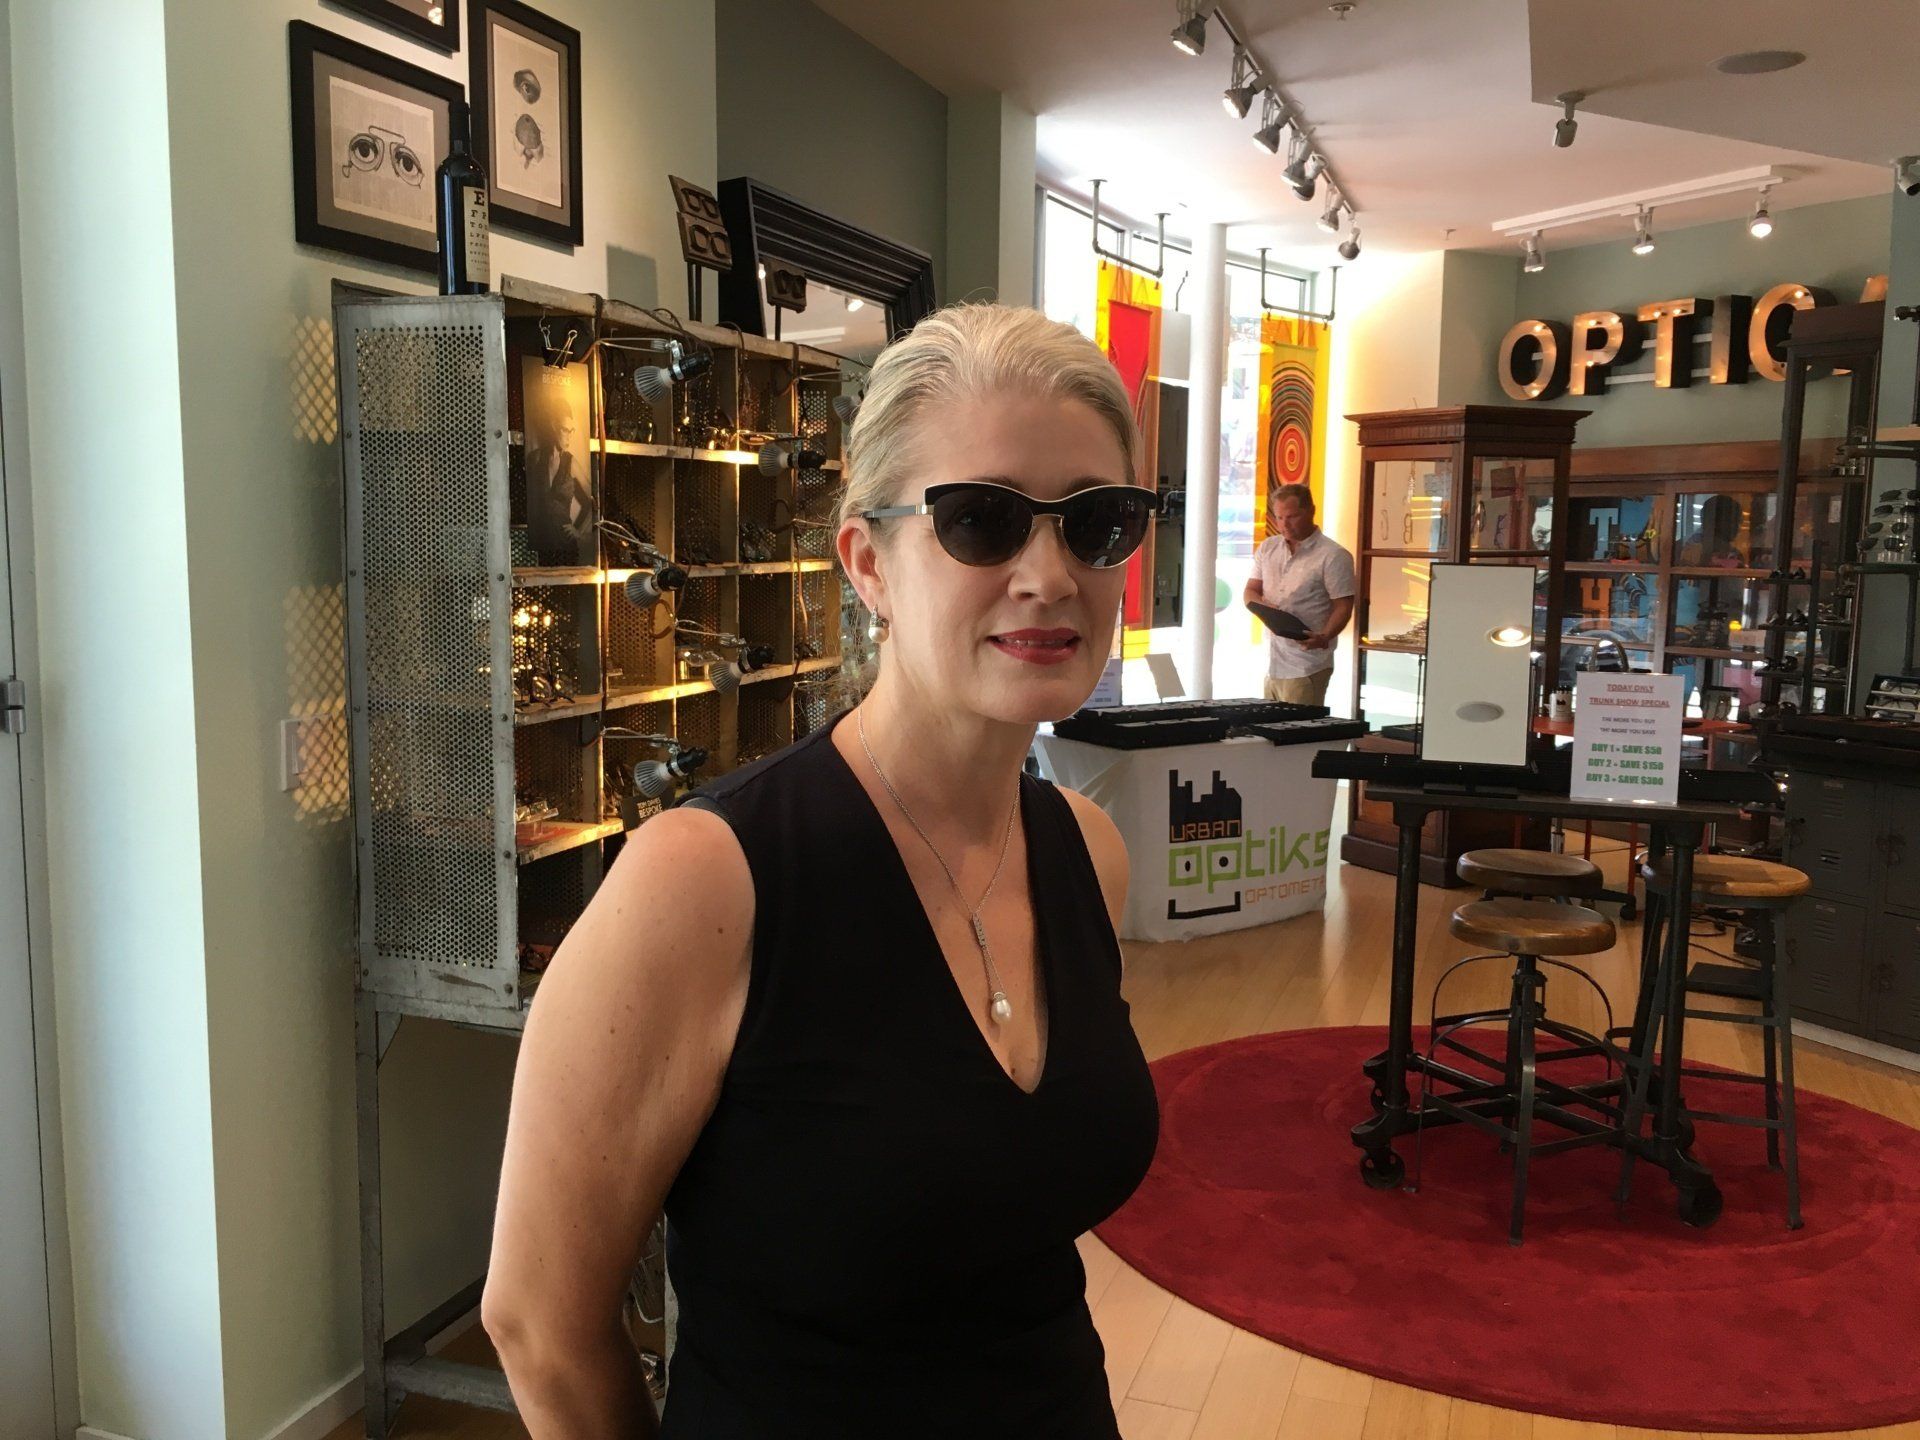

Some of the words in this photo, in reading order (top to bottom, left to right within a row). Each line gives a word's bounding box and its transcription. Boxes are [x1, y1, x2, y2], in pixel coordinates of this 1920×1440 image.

[474, 191, 485, 206] E
[1498, 274, 1889, 401] OPTIC
[1607, 684, 1633, 693] TODAY
[1634, 685, 1655, 694] ONLY
[1589, 697, 1614, 706] TRUNK
[1616, 698, 1639, 707] SHOW
[1641, 699, 1670, 708] SPECIAL
[1592, 743, 1608, 752] BUY
[1622, 745, 1643, 754] SAVE
[1645, 746, 1662, 755] $50
[1588, 758, 1605, 767] BUY
[1620, 760, 1641, 769] SAVE
[1642, 761, 1664, 770] $150
[1586, 773, 1603, 782] BUY
[1618, 775, 1639, 784] SAVE
[1641, 776, 1664, 785] $300
